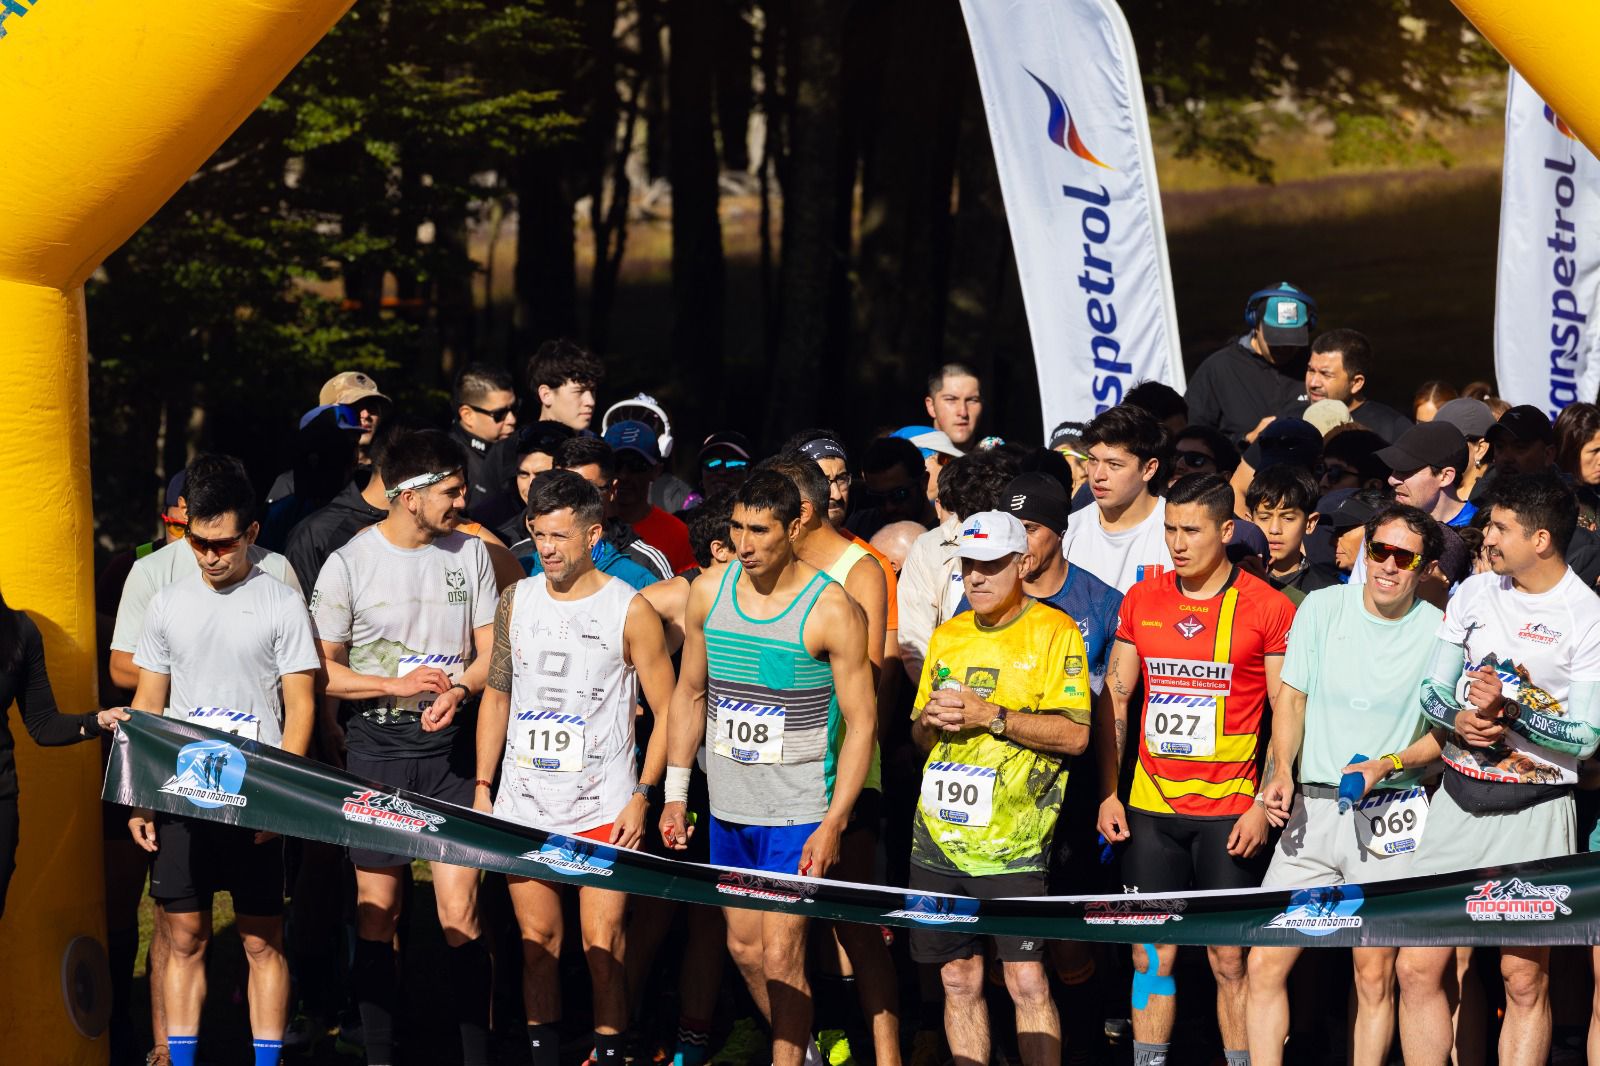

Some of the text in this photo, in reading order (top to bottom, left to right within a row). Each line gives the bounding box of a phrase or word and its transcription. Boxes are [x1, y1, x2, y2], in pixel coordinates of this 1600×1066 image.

[447, 590, 468, 603] OTSO
[1178, 604, 1209, 613] CASAB
[1149, 662, 1226, 679] HITACHI
[726, 719, 769, 743] 108
[1155, 712, 1201, 736] 027
[528, 729, 571, 752] 119
[176, 786, 207, 798] ANDINO
[935, 780, 979, 805] 190
[343, 802, 427, 827] INDOMITO
[1370, 808, 1418, 837] 069
[1467, 901, 1556, 913] INDOMITO
